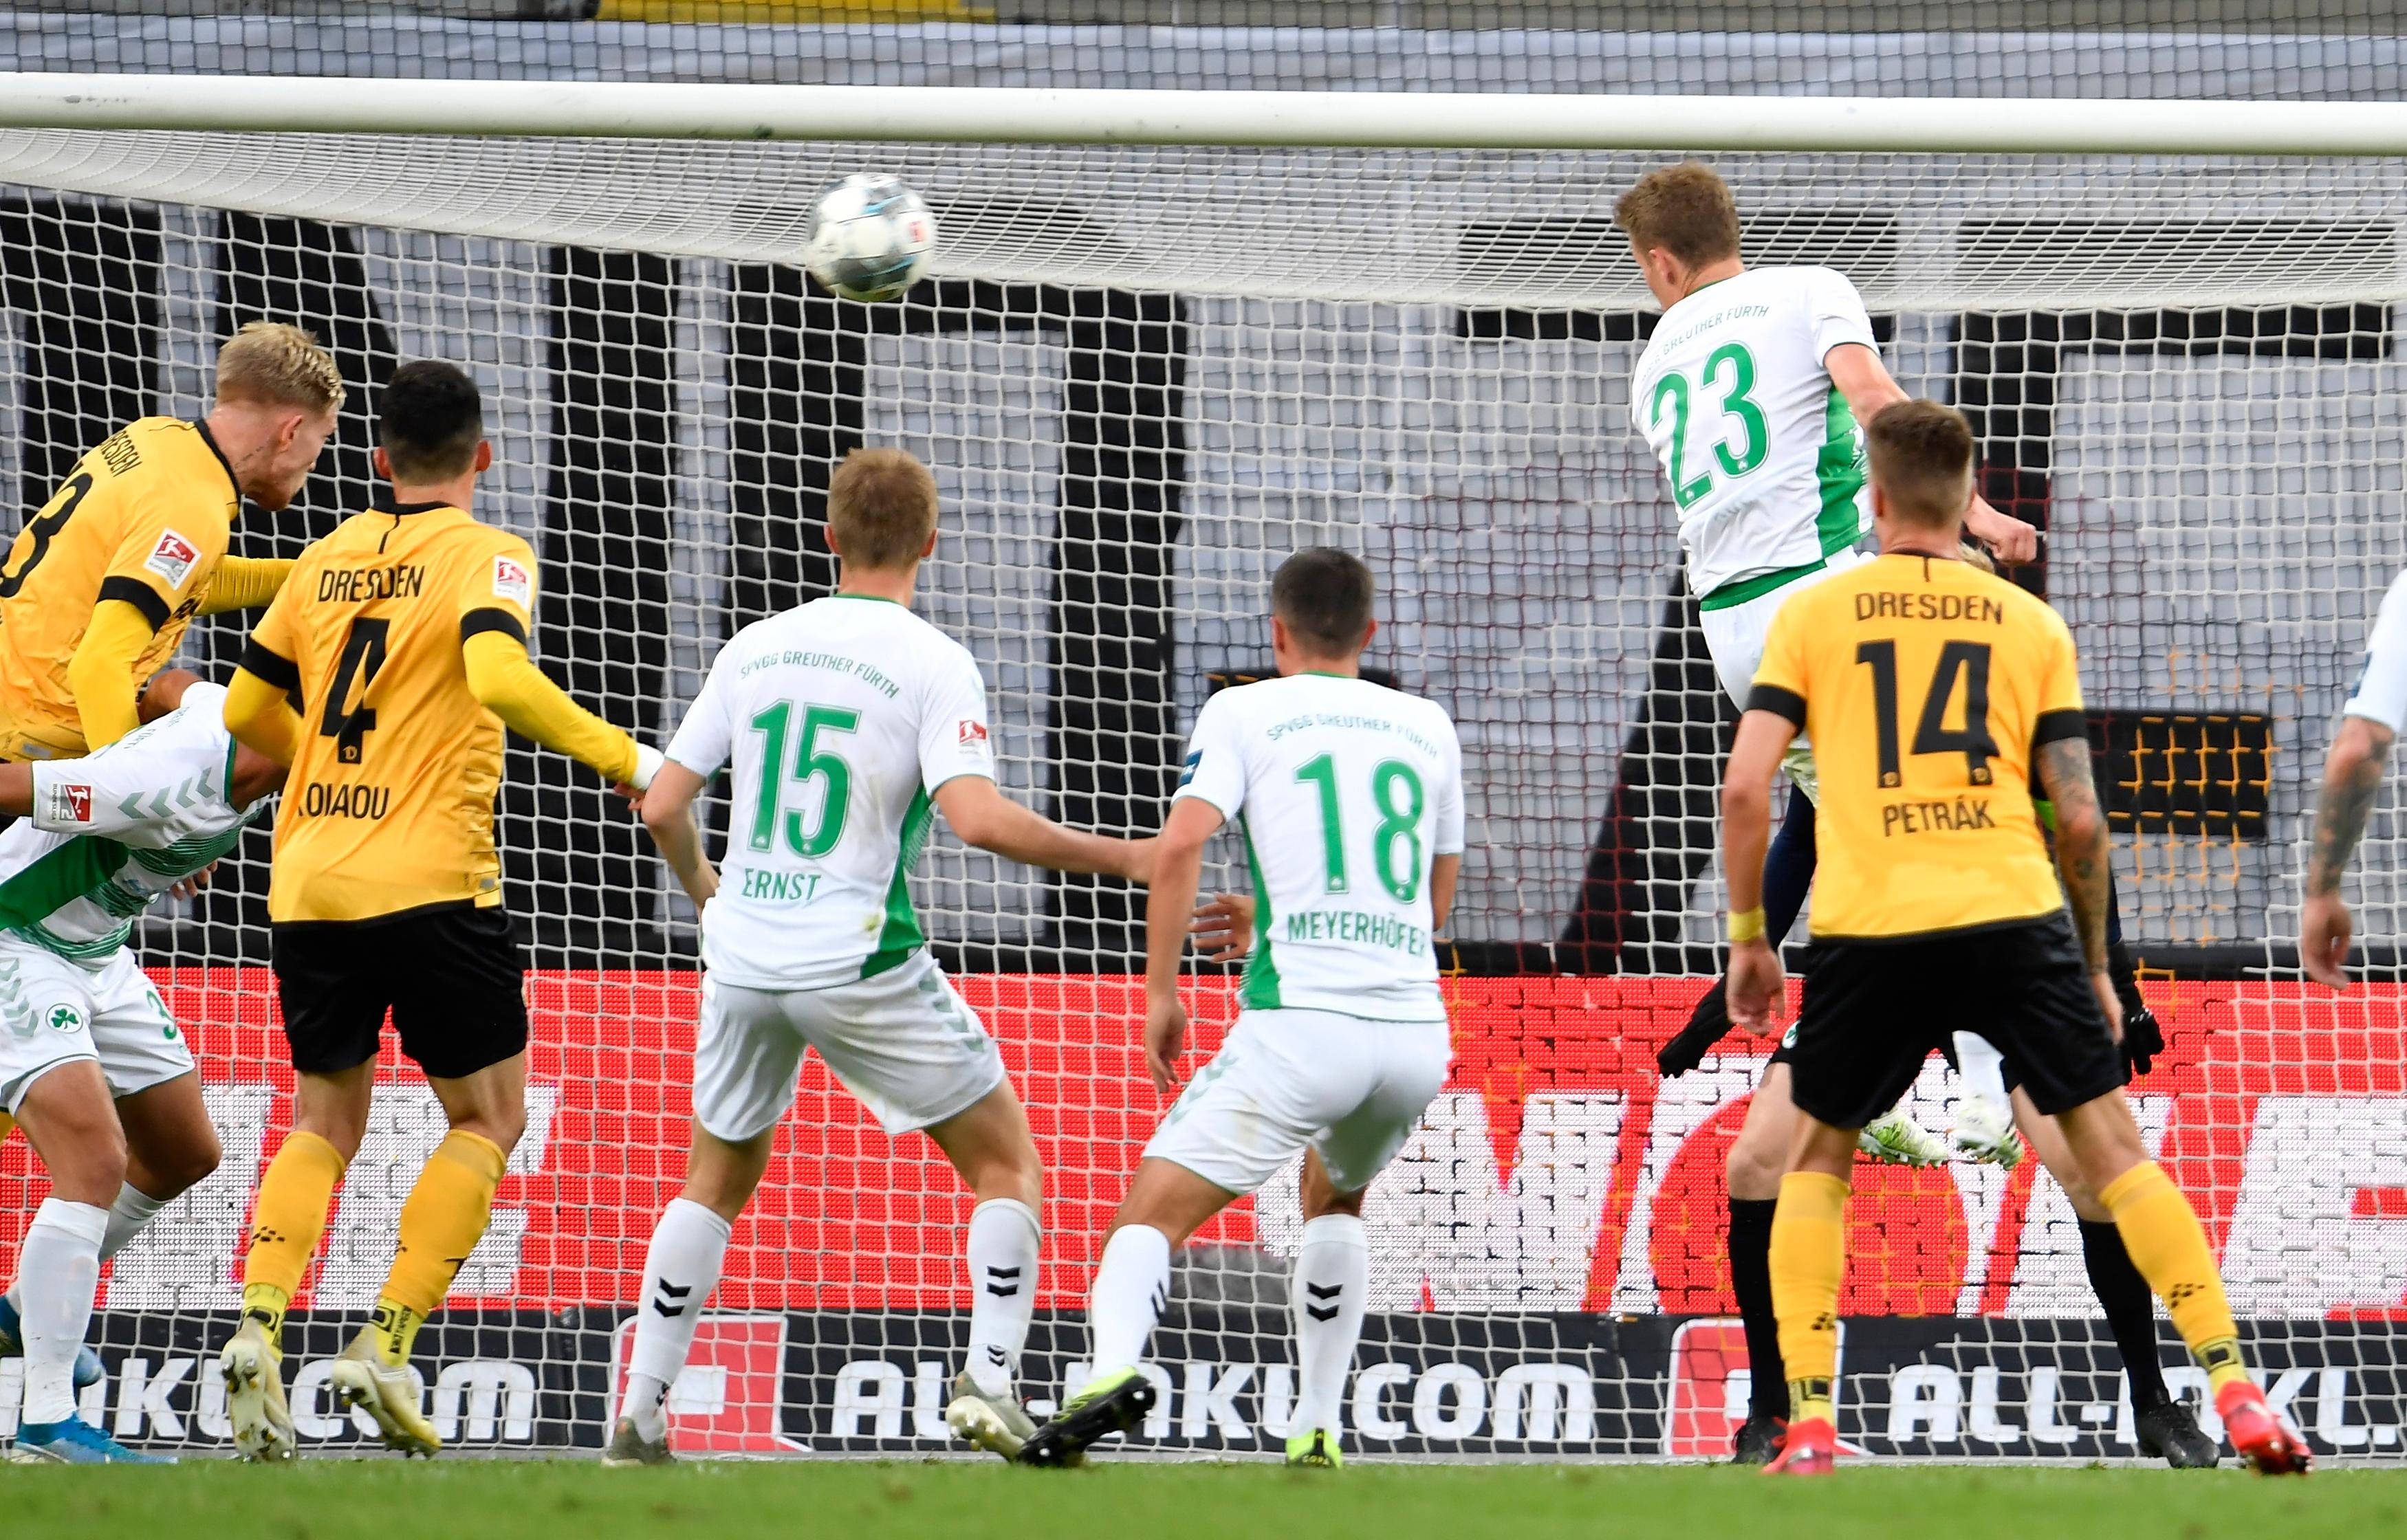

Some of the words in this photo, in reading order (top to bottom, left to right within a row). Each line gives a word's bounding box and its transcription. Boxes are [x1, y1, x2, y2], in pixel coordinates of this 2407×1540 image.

[1726, 303, 1770, 324] FÜRTH
[1651, 340, 1772, 512] 23
[99, 430, 142, 478] RESDEN
[1855, 592, 2003, 624] DRESDEN
[320, 617, 391, 764] 4
[783, 650, 854, 674] GREUTHER
[854, 663, 900, 699] FÜRTH
[1316, 713, 1391, 732] GREUTHER
[1855, 639, 2000, 789] 14
[748, 698, 862, 859] 15
[1293, 751, 1426, 905] 18
[1882, 795, 1996, 837] PETRÁK
[741, 867, 821, 902] ERNST
